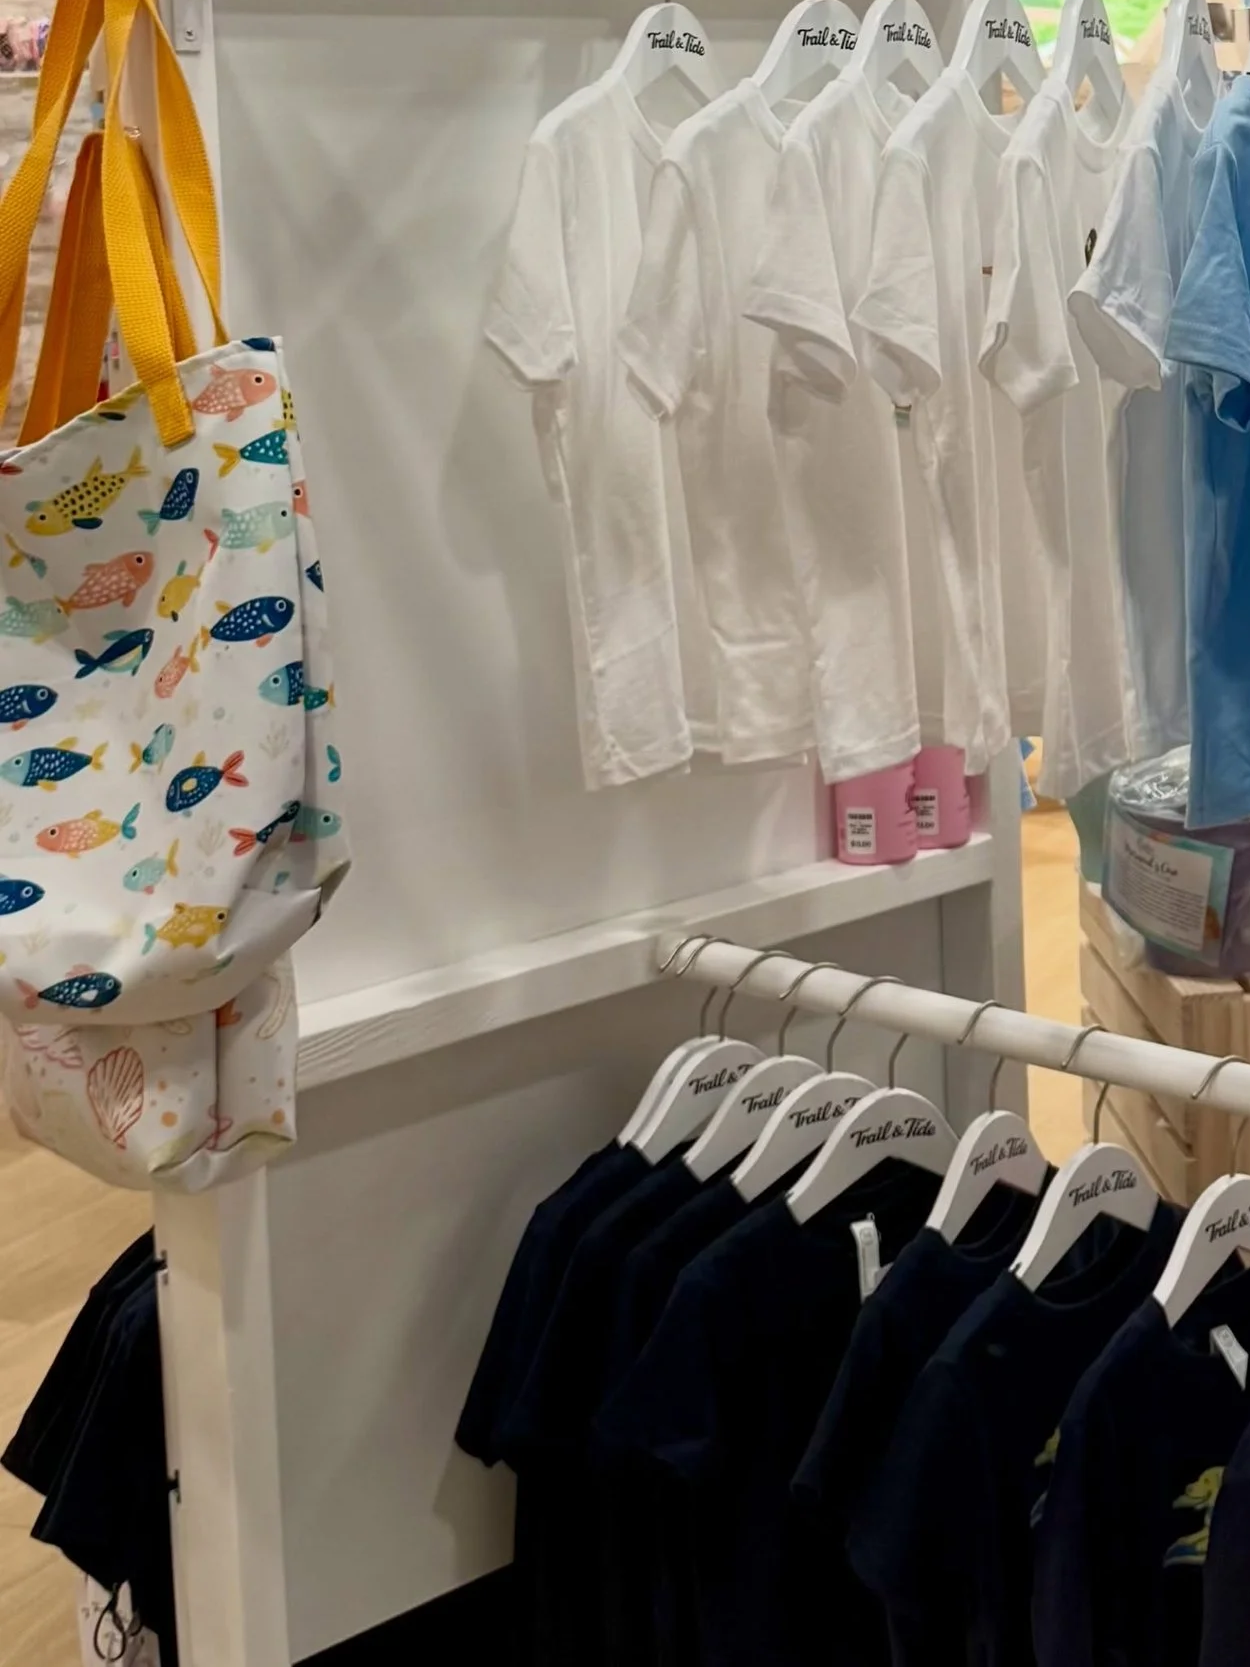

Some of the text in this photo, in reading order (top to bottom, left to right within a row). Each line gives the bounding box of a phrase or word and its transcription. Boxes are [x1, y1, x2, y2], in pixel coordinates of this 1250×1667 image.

[647, 30, 675, 50] Trail
[683, 32, 705, 56] Tide
[798, 27, 829, 47] Trail
[838, 29, 858, 51] Tid
[883, 22, 906, 43] Trail
[913, 23, 932, 49] Tide
[985, 18, 1007, 40] Trail
[1013, 20, 1032, 47] Tide
[688, 1068, 727, 1095] Trail
[741, 1087, 784, 1113] Trail
[788, 1101, 832, 1128] Trail
[850, 1120, 893, 1148] Trail
[904, 1117, 936, 1139] Tide
[969, 1143, 998, 1175] Trail
[1005, 1137, 1028, 1159] Tide
[1068, 1175, 1103, 1207] Trail
[1111, 1169, 1138, 1193] Tide
[1205, 1210, 1238, 1243] Trail
